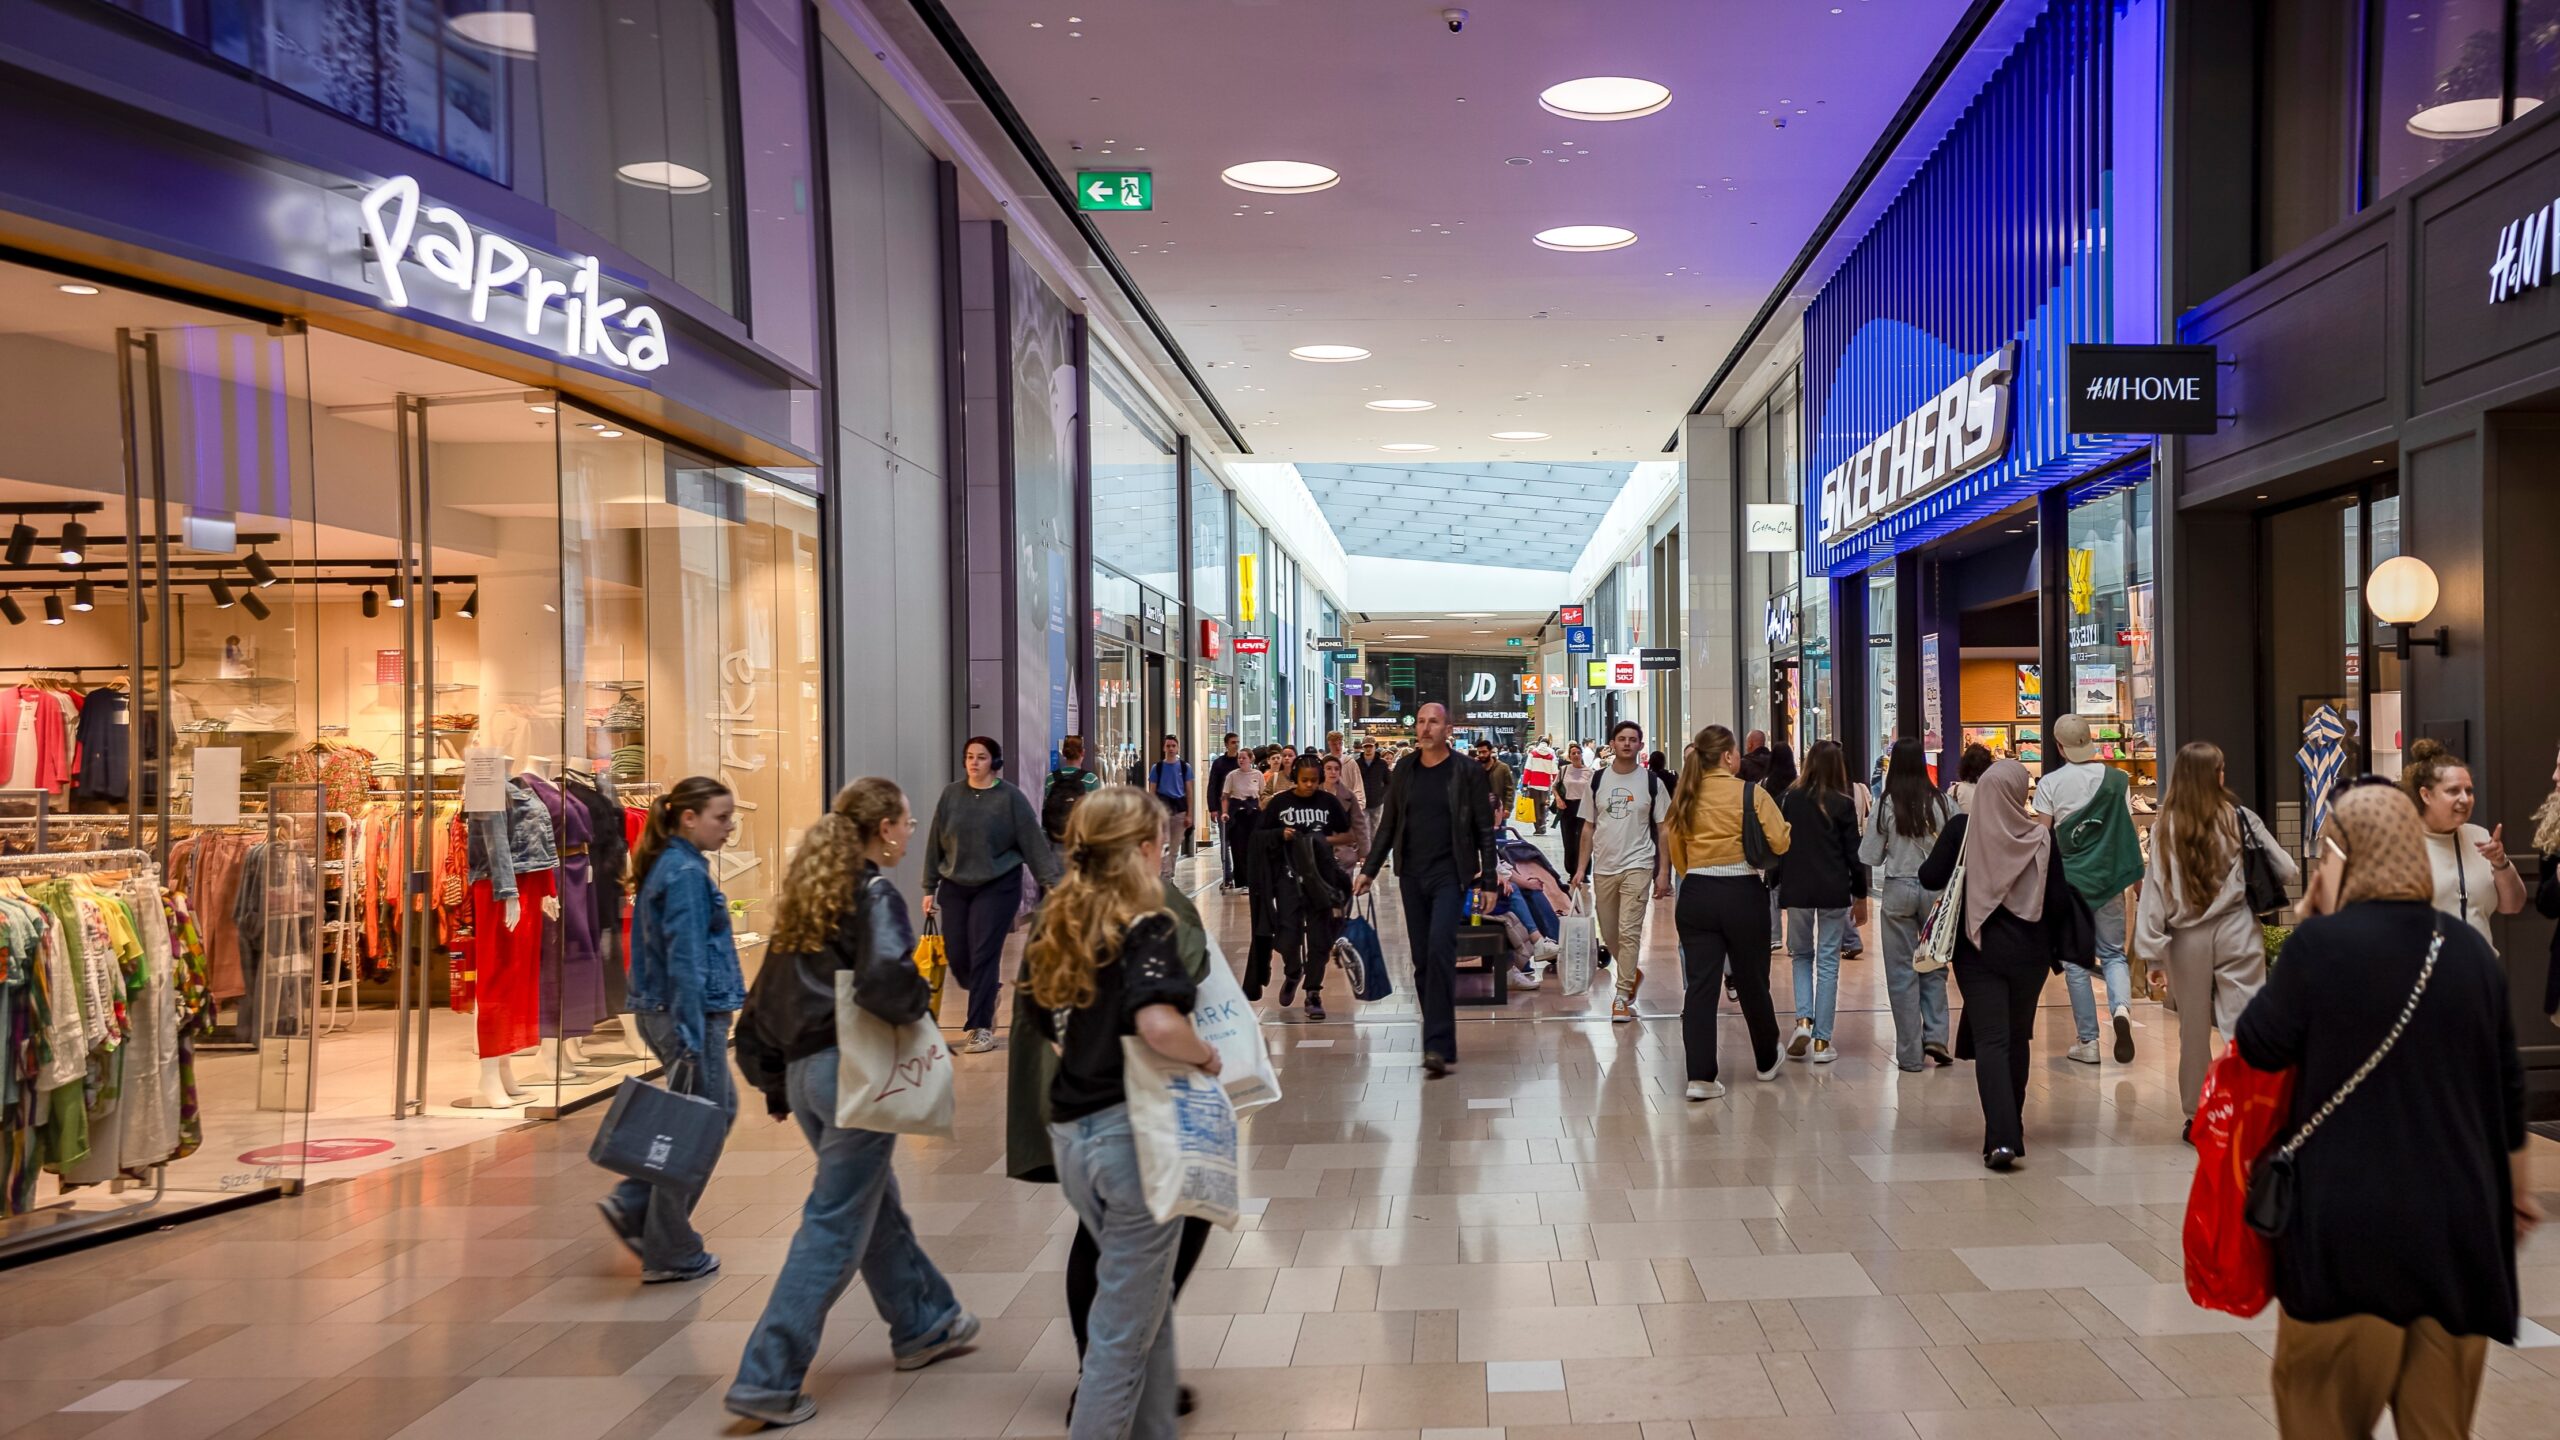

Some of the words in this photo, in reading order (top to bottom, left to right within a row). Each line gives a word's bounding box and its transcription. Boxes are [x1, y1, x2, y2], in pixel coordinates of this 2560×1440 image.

[2489, 205, 2550, 305] H&M
[361, 175, 670, 371] Paprika
[2086, 377, 2120, 400] H&M
[2122, 377, 2200, 400] HOME
[1819, 349, 2002, 545] SKECHERS
[1464, 672, 1497, 702] JD
[1477, 711, 1494, 719] KING
[1279, 806, 1330, 827] Tupac
[219, 1173, 251, 1191] Size
